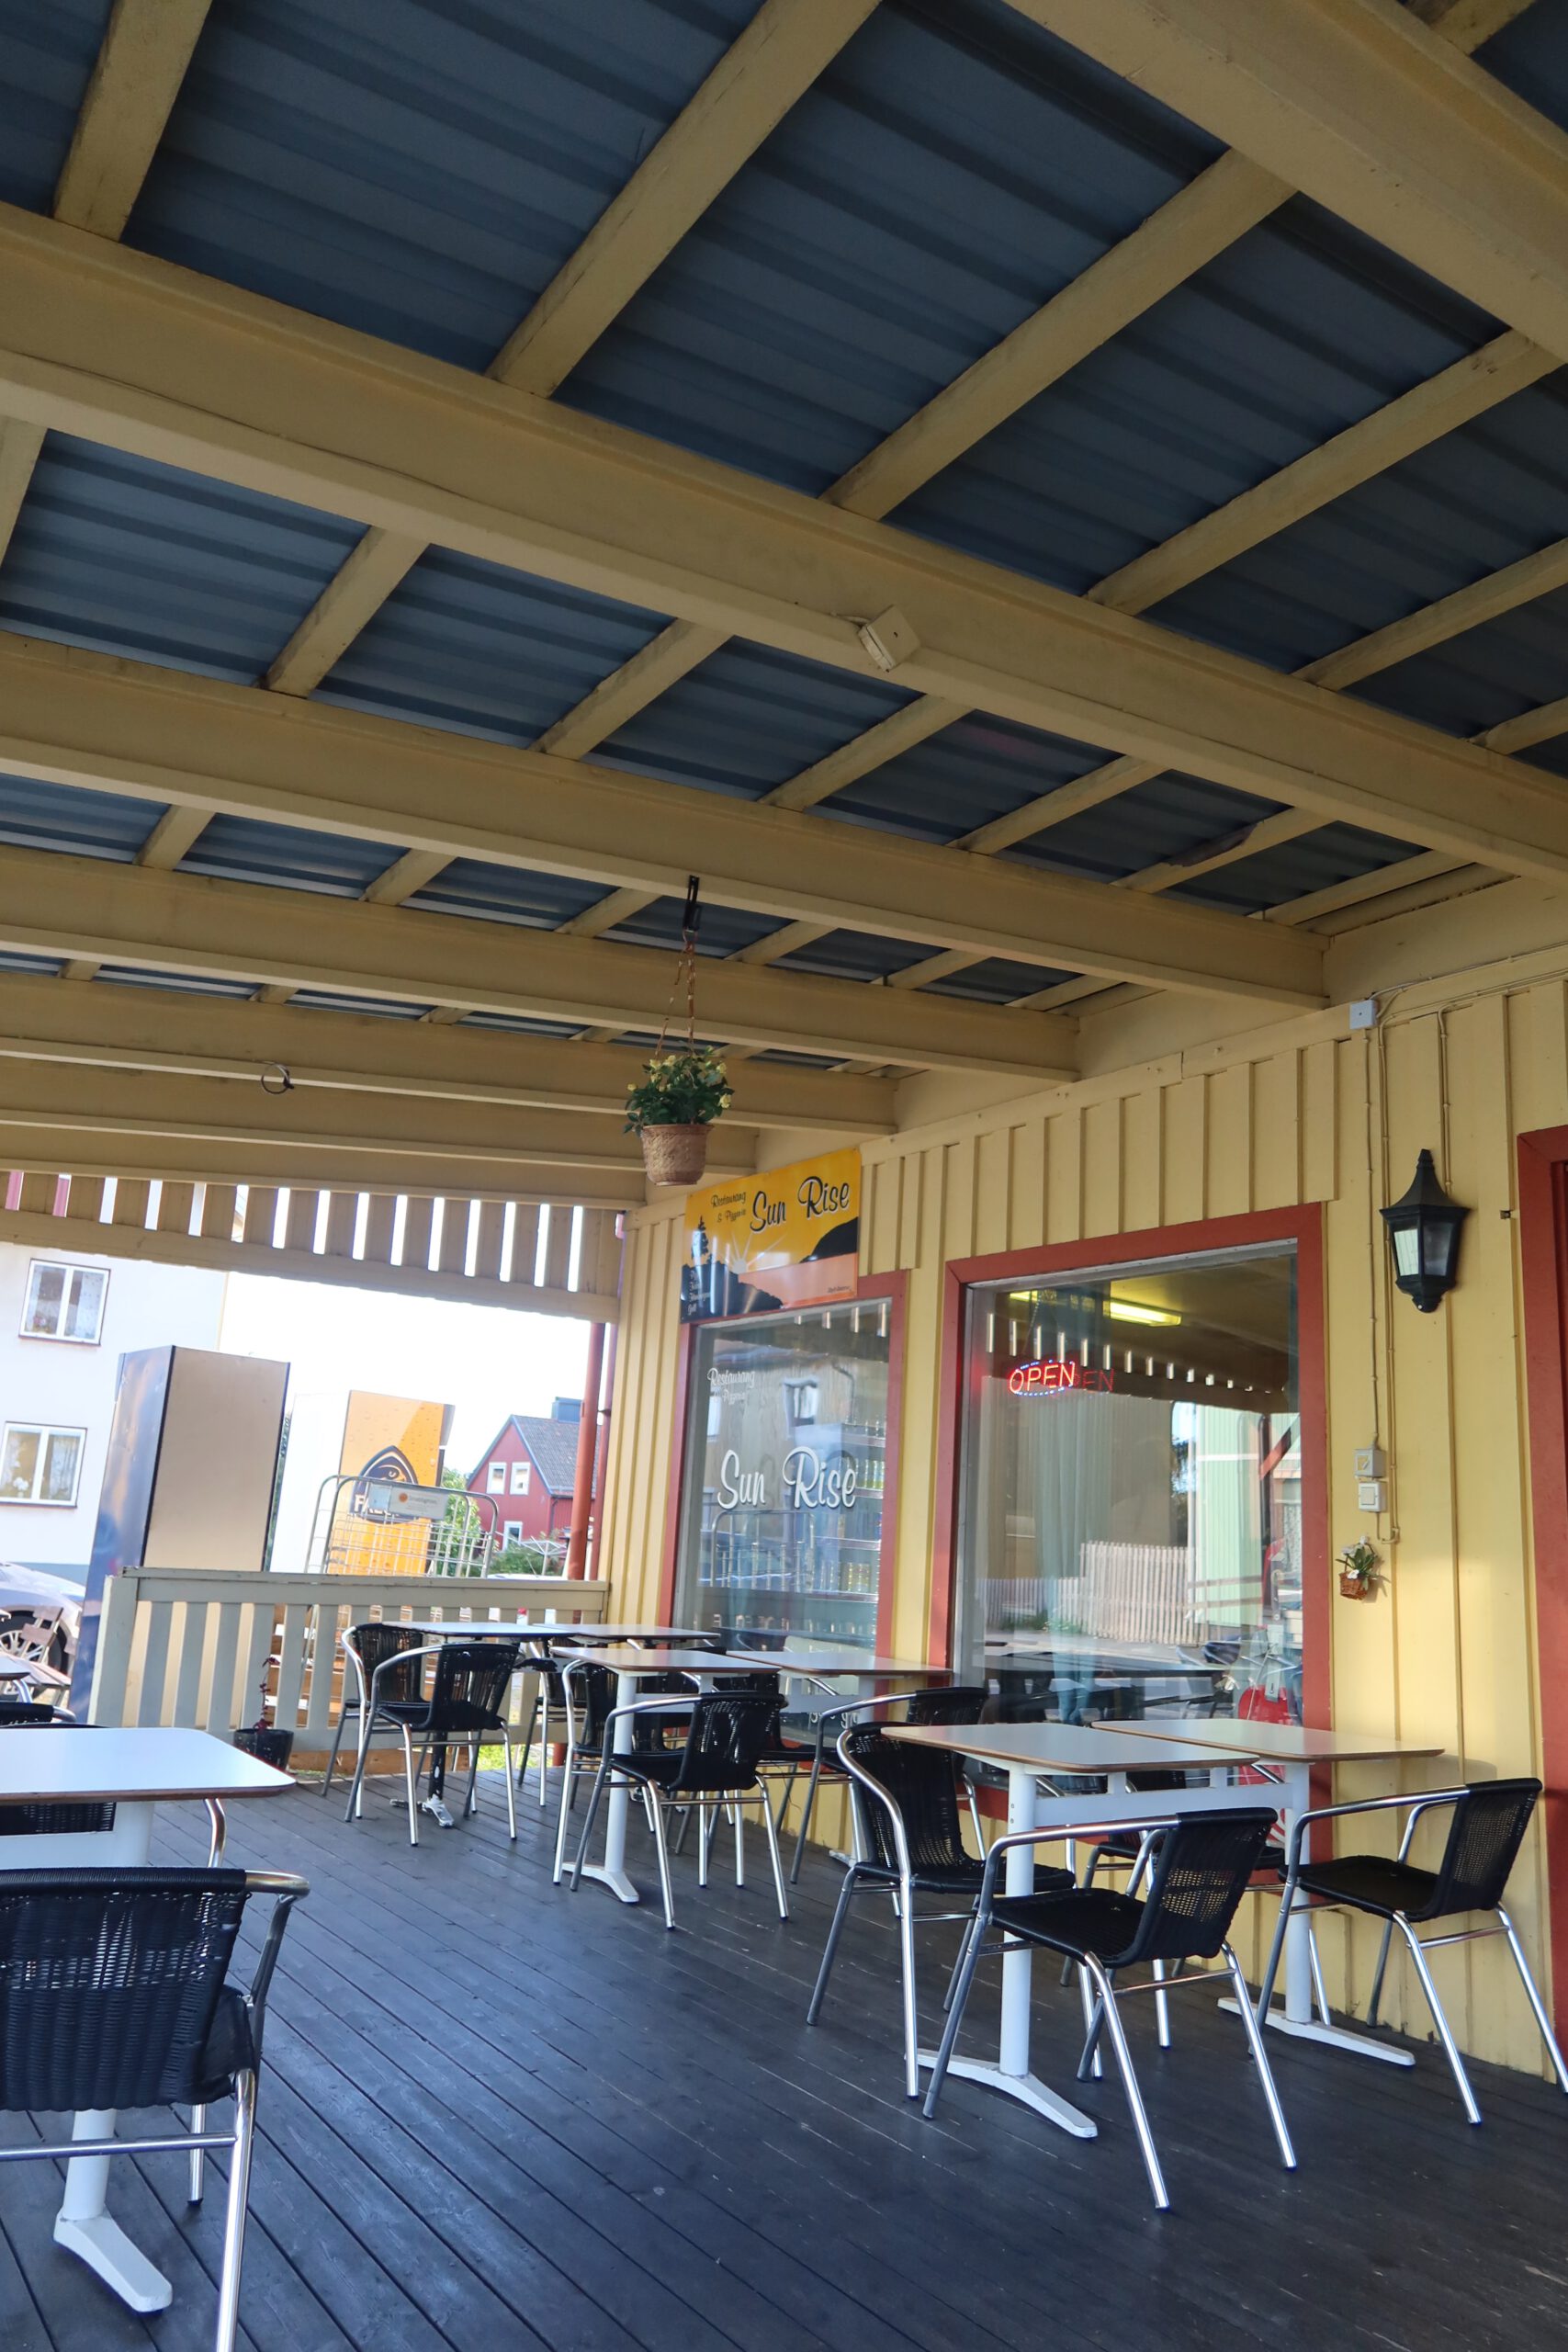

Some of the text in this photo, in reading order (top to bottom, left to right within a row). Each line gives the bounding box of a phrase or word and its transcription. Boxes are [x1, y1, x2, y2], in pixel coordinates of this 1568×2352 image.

[750, 1176, 850, 1232] Sun Rise
[707, 1368, 755, 1388] Restaurang
[1010, 1362, 1075, 1393] OPEN
[717, 1446, 856, 1510] Sun Rise
